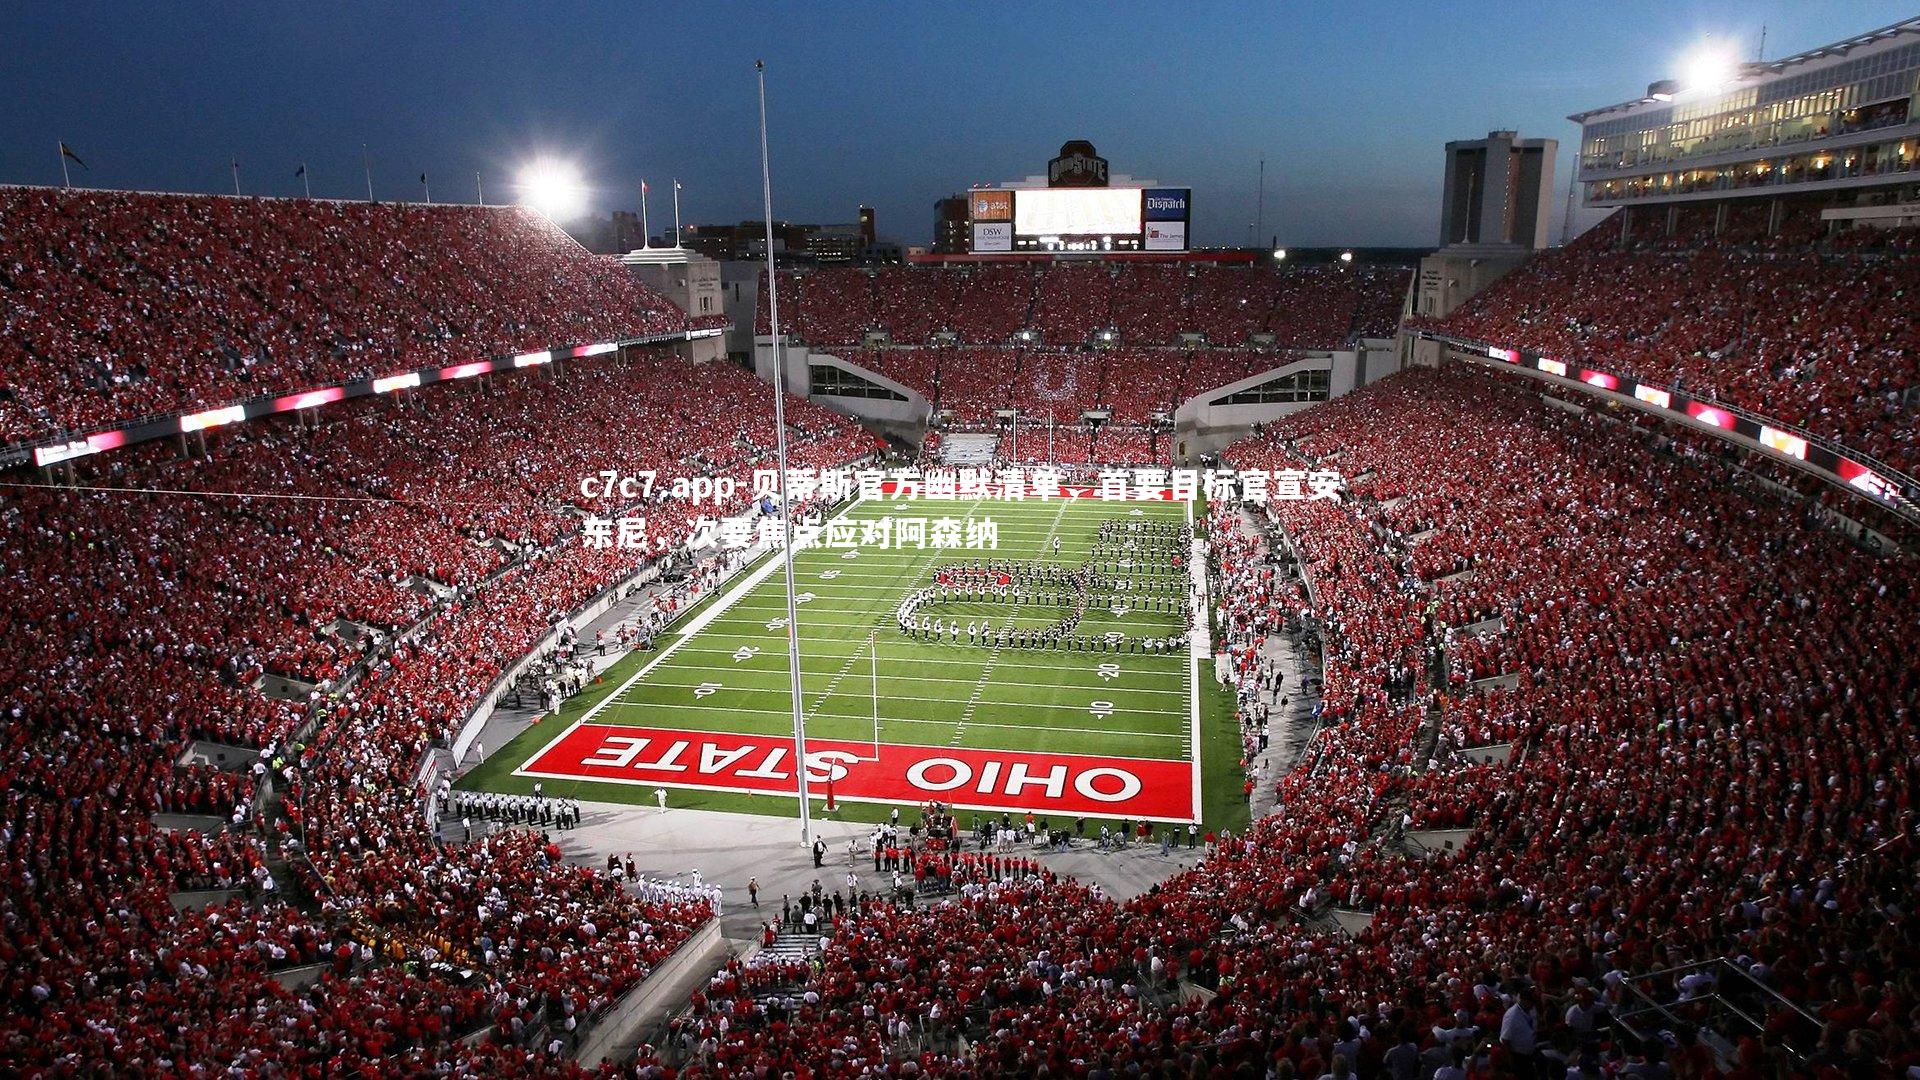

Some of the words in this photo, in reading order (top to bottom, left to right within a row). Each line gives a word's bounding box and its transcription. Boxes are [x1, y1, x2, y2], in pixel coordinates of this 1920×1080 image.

[1147, 197, 1186, 211] Dispatch
[983, 228, 1002, 236] DSW
[1097, 663, 1120, 677] 20
[693, 682, 723, 696] 10
[1088, 700, 1114, 715] 10
[579, 735, 860, 784] STATE
[905, 756, 1142, 803] OHIO
